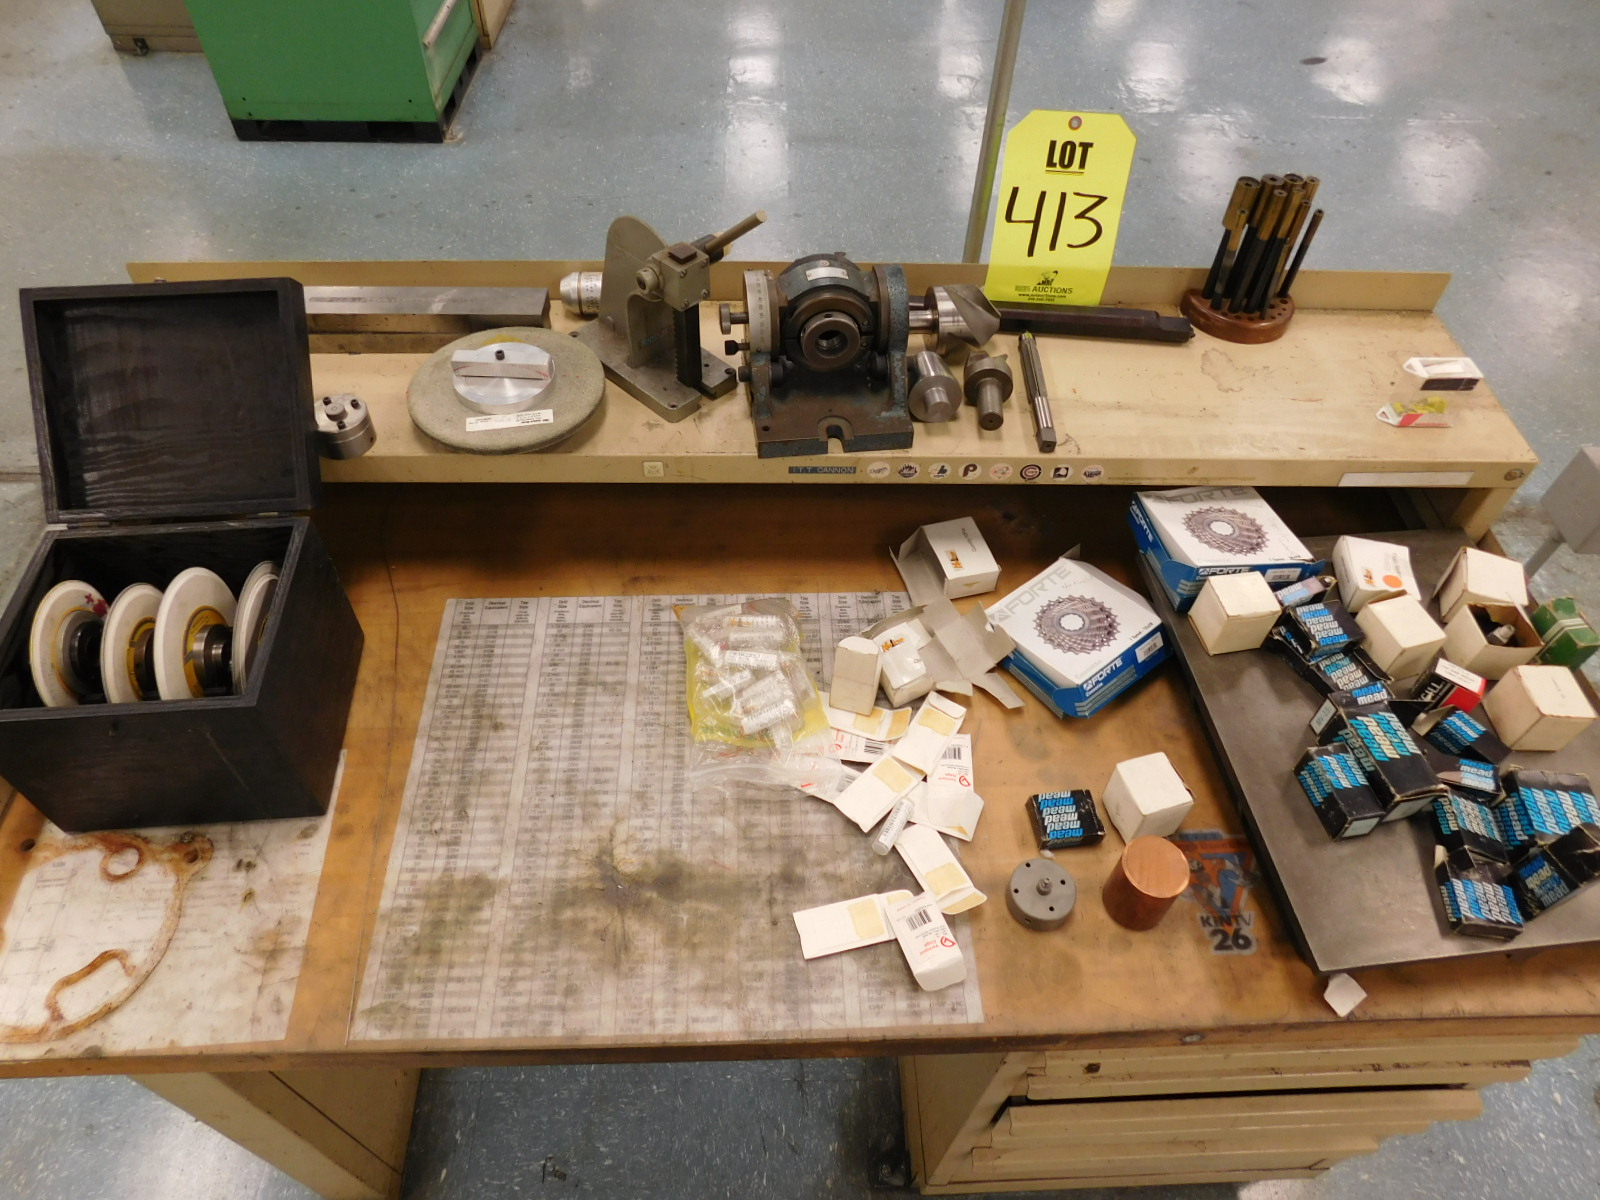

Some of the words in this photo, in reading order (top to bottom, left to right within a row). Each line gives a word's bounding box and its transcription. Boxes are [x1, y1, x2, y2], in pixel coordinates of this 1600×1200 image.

[1045, 140, 1094, 170] LOT
[1005, 186, 1108, 258] 413
[1031, 285, 1073, 294] AUCTIONS
[1004, 565, 1072, 616] FORTE
[1296, 603, 1325, 616] mead
[1306, 614, 1334, 628] mead
[1310, 620, 1339, 634] mead
[1315, 627, 1344, 642] mead
[1091, 656, 1124, 687] FORTE
[1325, 657, 1351, 676] mead
[1330, 662, 1356, 683] mead
[1336, 668, 1363, 690] mead
[1357, 689, 1388, 706] mead
[1349, 718, 1390, 761] mead
[1356, 716, 1400, 758] mead
[1368, 714, 1412, 756] mead
[1378, 711, 1422, 754] mead
[1338, 728, 1376, 772] mead
[1304, 765, 1329, 798] mead
[1308, 760, 1332, 793] mead
[1317, 756, 1344, 790] mead
[1322, 756, 1353, 788] mead
[1332, 754, 1362, 787] mead
[1338, 753, 1370, 786] mead
[1460, 765, 1494, 778] mead
[1038, 790, 1071, 802] mead
[1298, 775, 1320, 806] mead
[1300, 770, 1324, 803] mead
[1040, 797, 1074, 810] mead
[1042, 804, 1076, 818] mead
[1044, 812, 1078, 826] mead
[1432, 802, 1452, 834] mead
[1438, 797, 1459, 831] mead
[1504, 798, 1529, 840] mead
[1510, 792, 1536, 834] mead
[1519, 786, 1553, 835] mead
[1530, 787, 1565, 836] mead
[1555, 789, 1581, 828] mea
[1047, 820, 1080, 834] mead
[1498, 803, 1522, 846] mead
[1526, 861, 1552, 889] mead
[1440, 886, 1457, 922] mead
[1451, 878, 1476, 919] mead
[1462, 879, 1486, 920] mead
[1472, 880, 1496, 922] mead
[1482, 882, 1507, 924] mead
[1492, 882, 1517, 925] mead
[1502, 884, 1524, 925] mead
[1540, 878, 1570, 908] mead
[1209, 928, 1252, 951] 26
